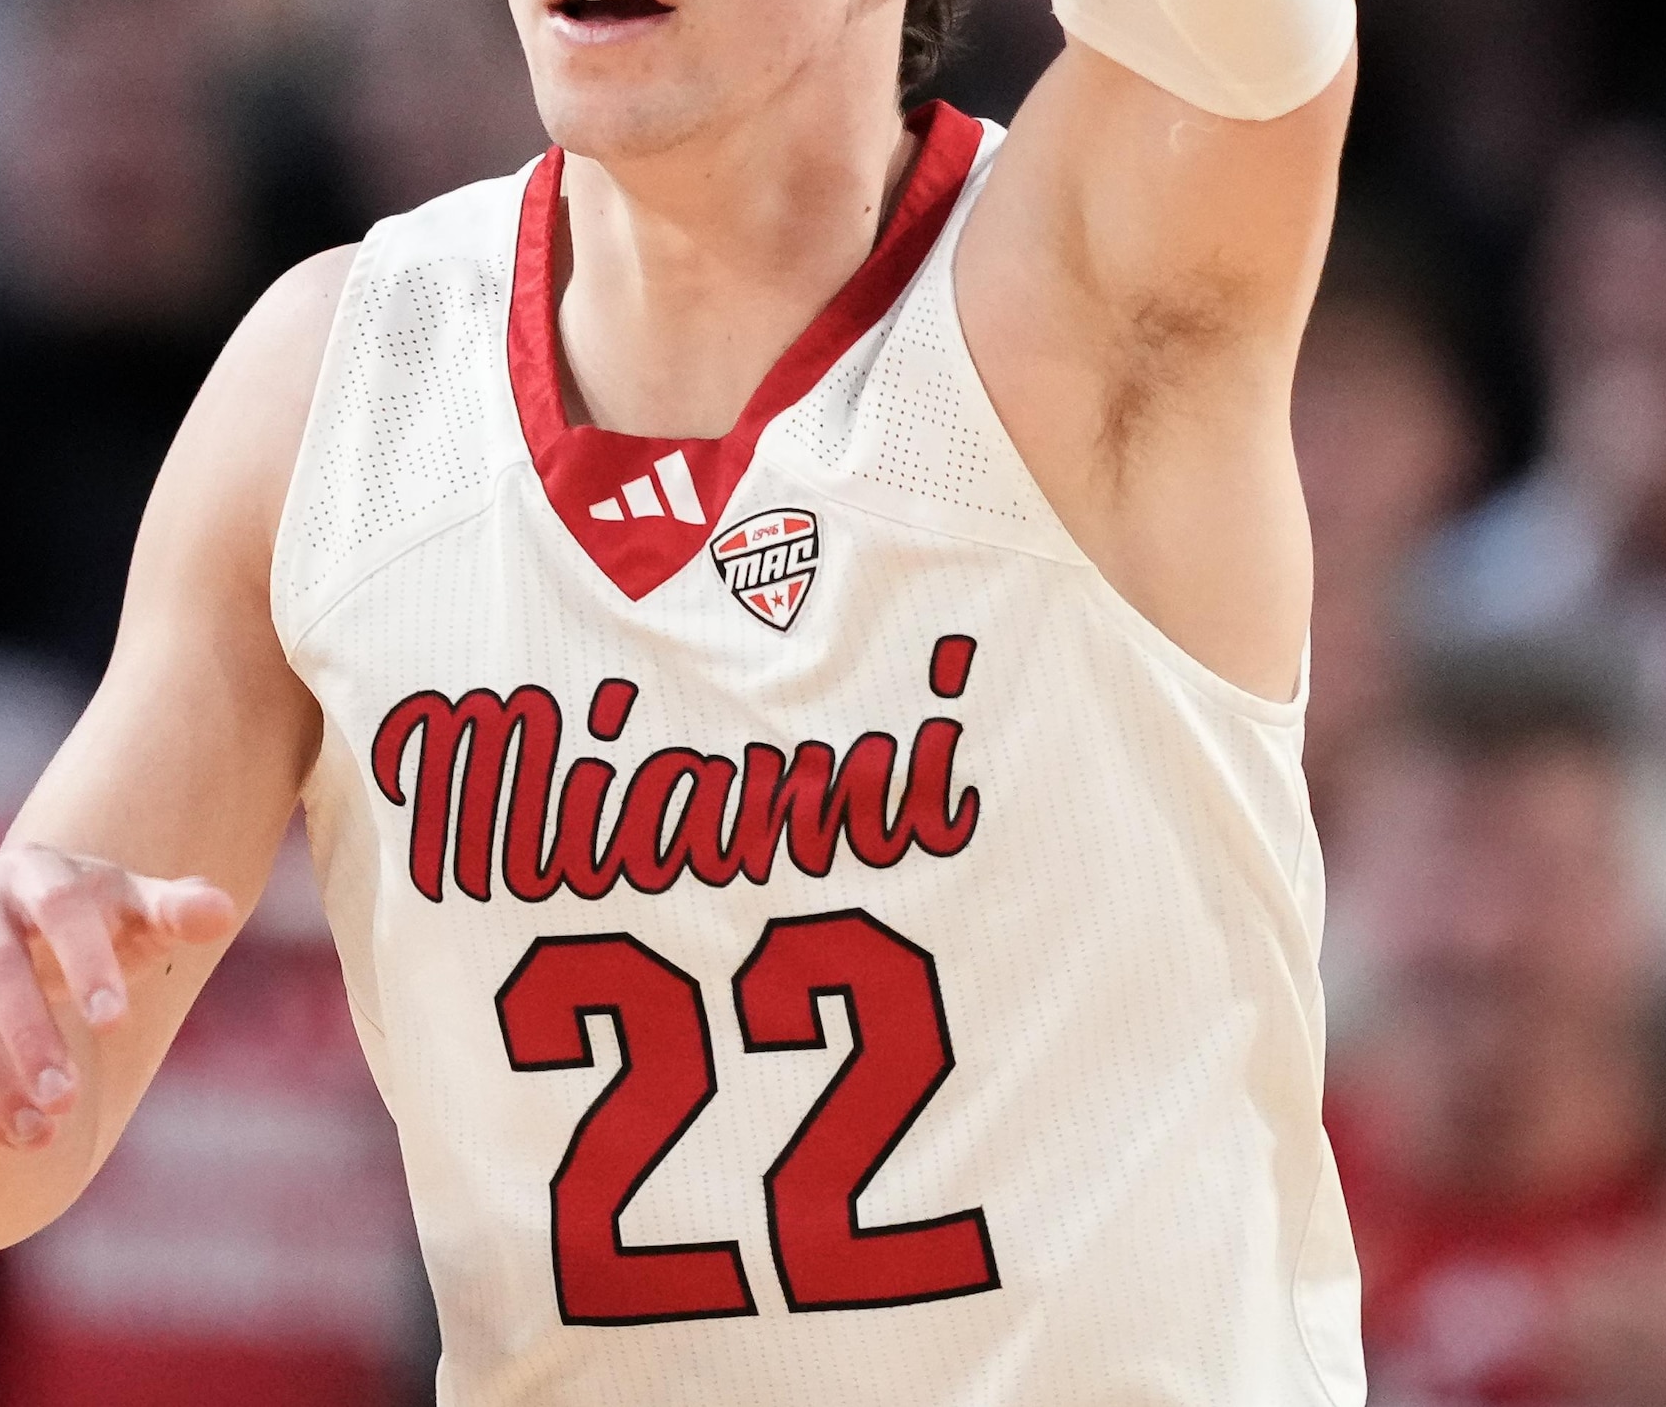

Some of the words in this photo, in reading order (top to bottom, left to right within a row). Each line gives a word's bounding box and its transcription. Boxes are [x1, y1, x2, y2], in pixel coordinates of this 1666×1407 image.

[723, 537, 819, 591] MAC
[371, 634, 981, 903] Miami
[495, 907, 1002, 1327] 22
